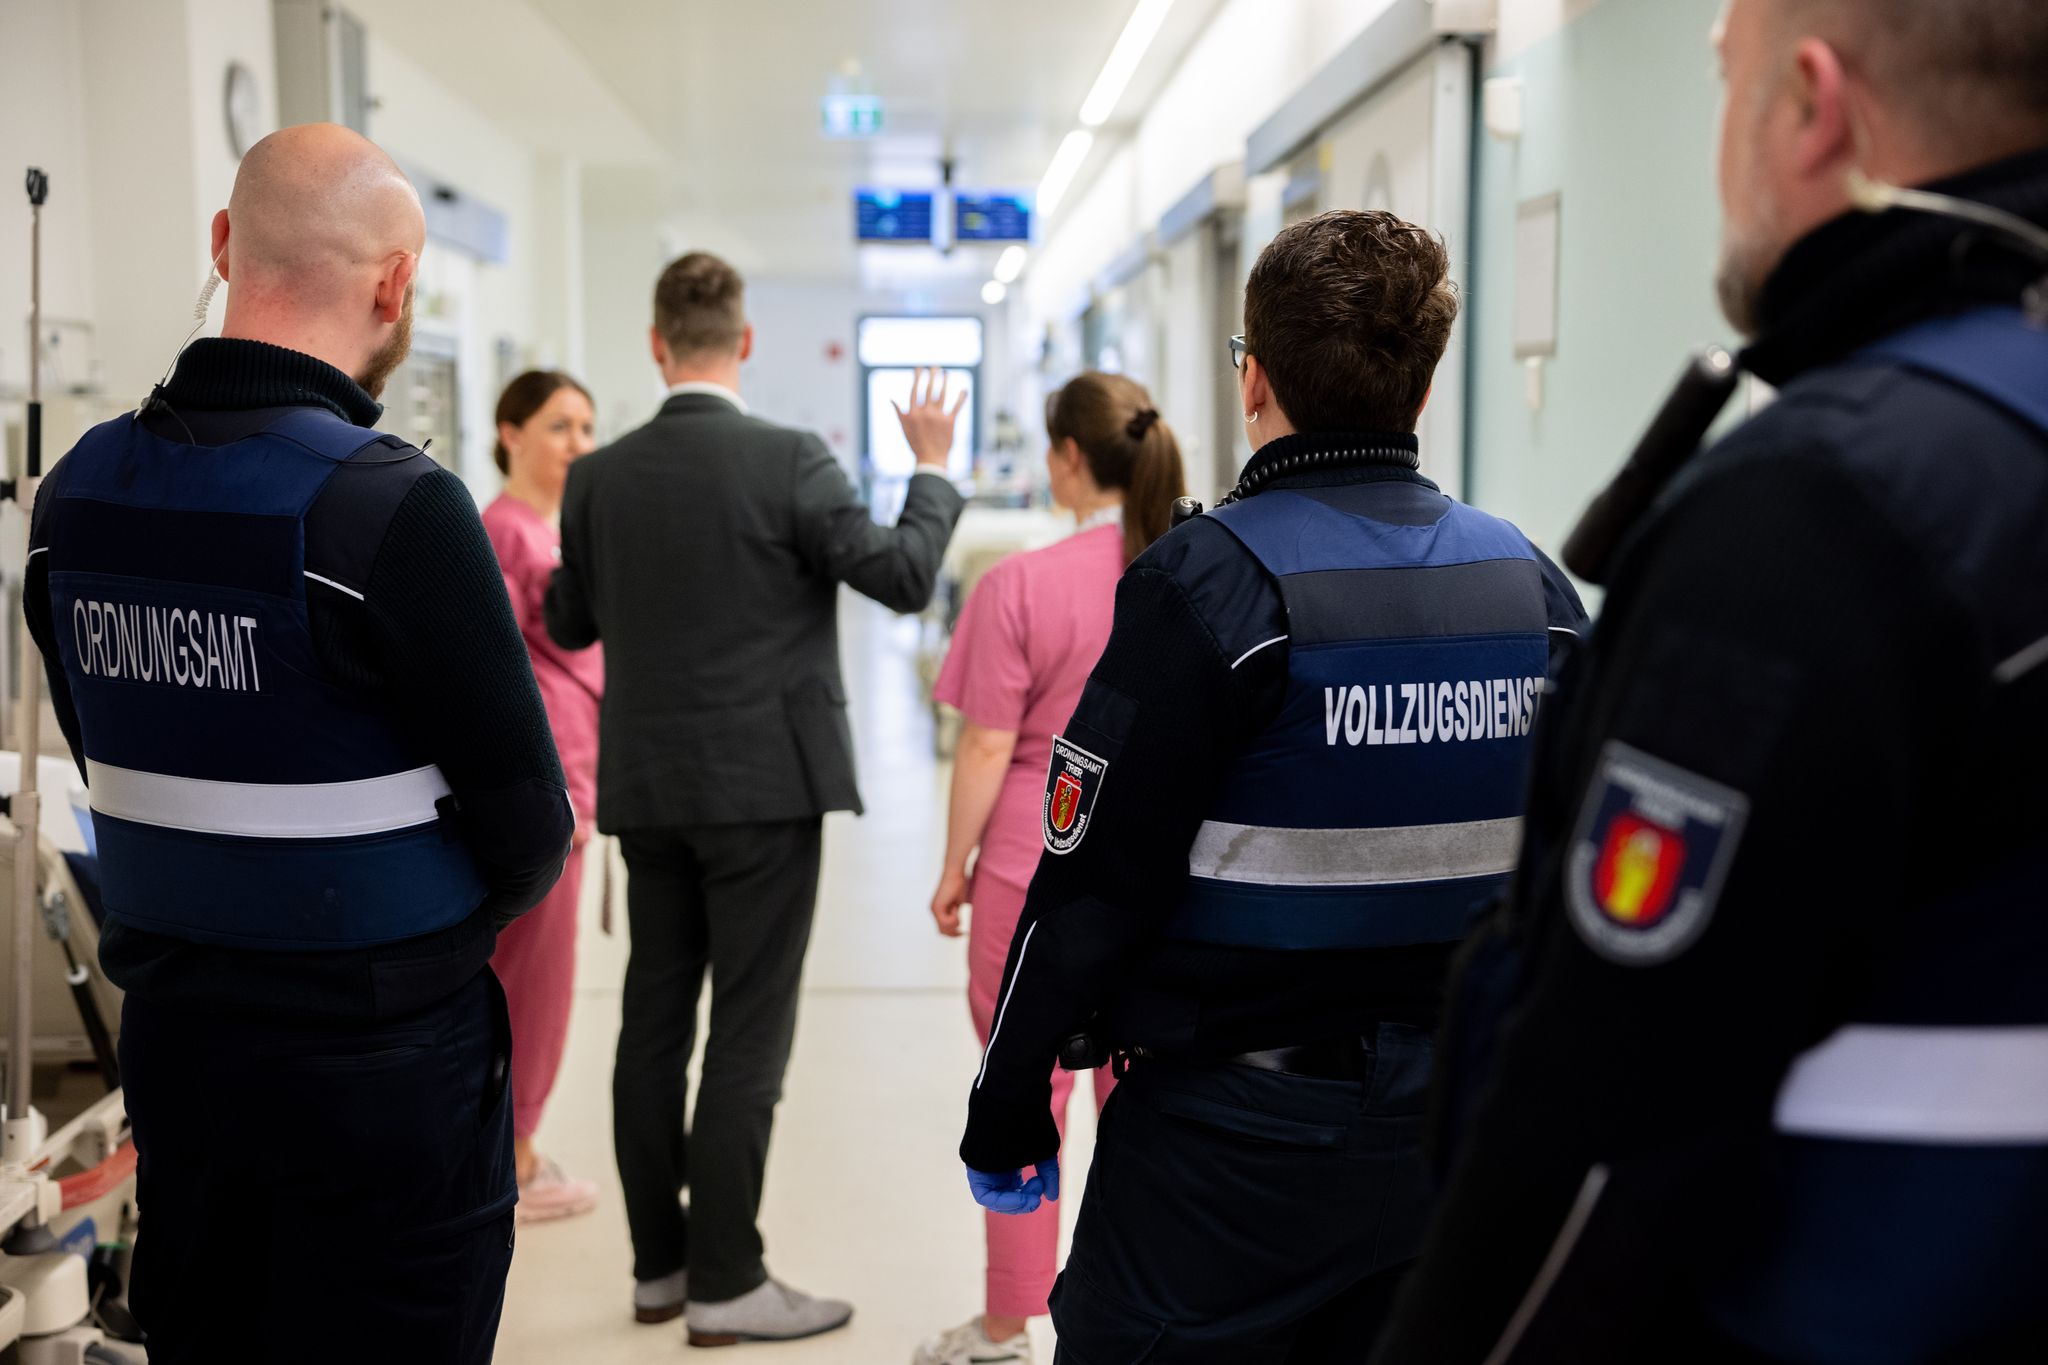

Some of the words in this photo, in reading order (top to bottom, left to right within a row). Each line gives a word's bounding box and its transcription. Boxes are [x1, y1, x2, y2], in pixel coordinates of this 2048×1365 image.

[74, 598, 260, 692] ORDNUNGSAMT
[1324, 676, 1546, 746] VOLLZUGSDIENST
[1055, 744, 1103, 776] ORDNUNGSAMT
[1065, 761, 1083, 779] TRIER
